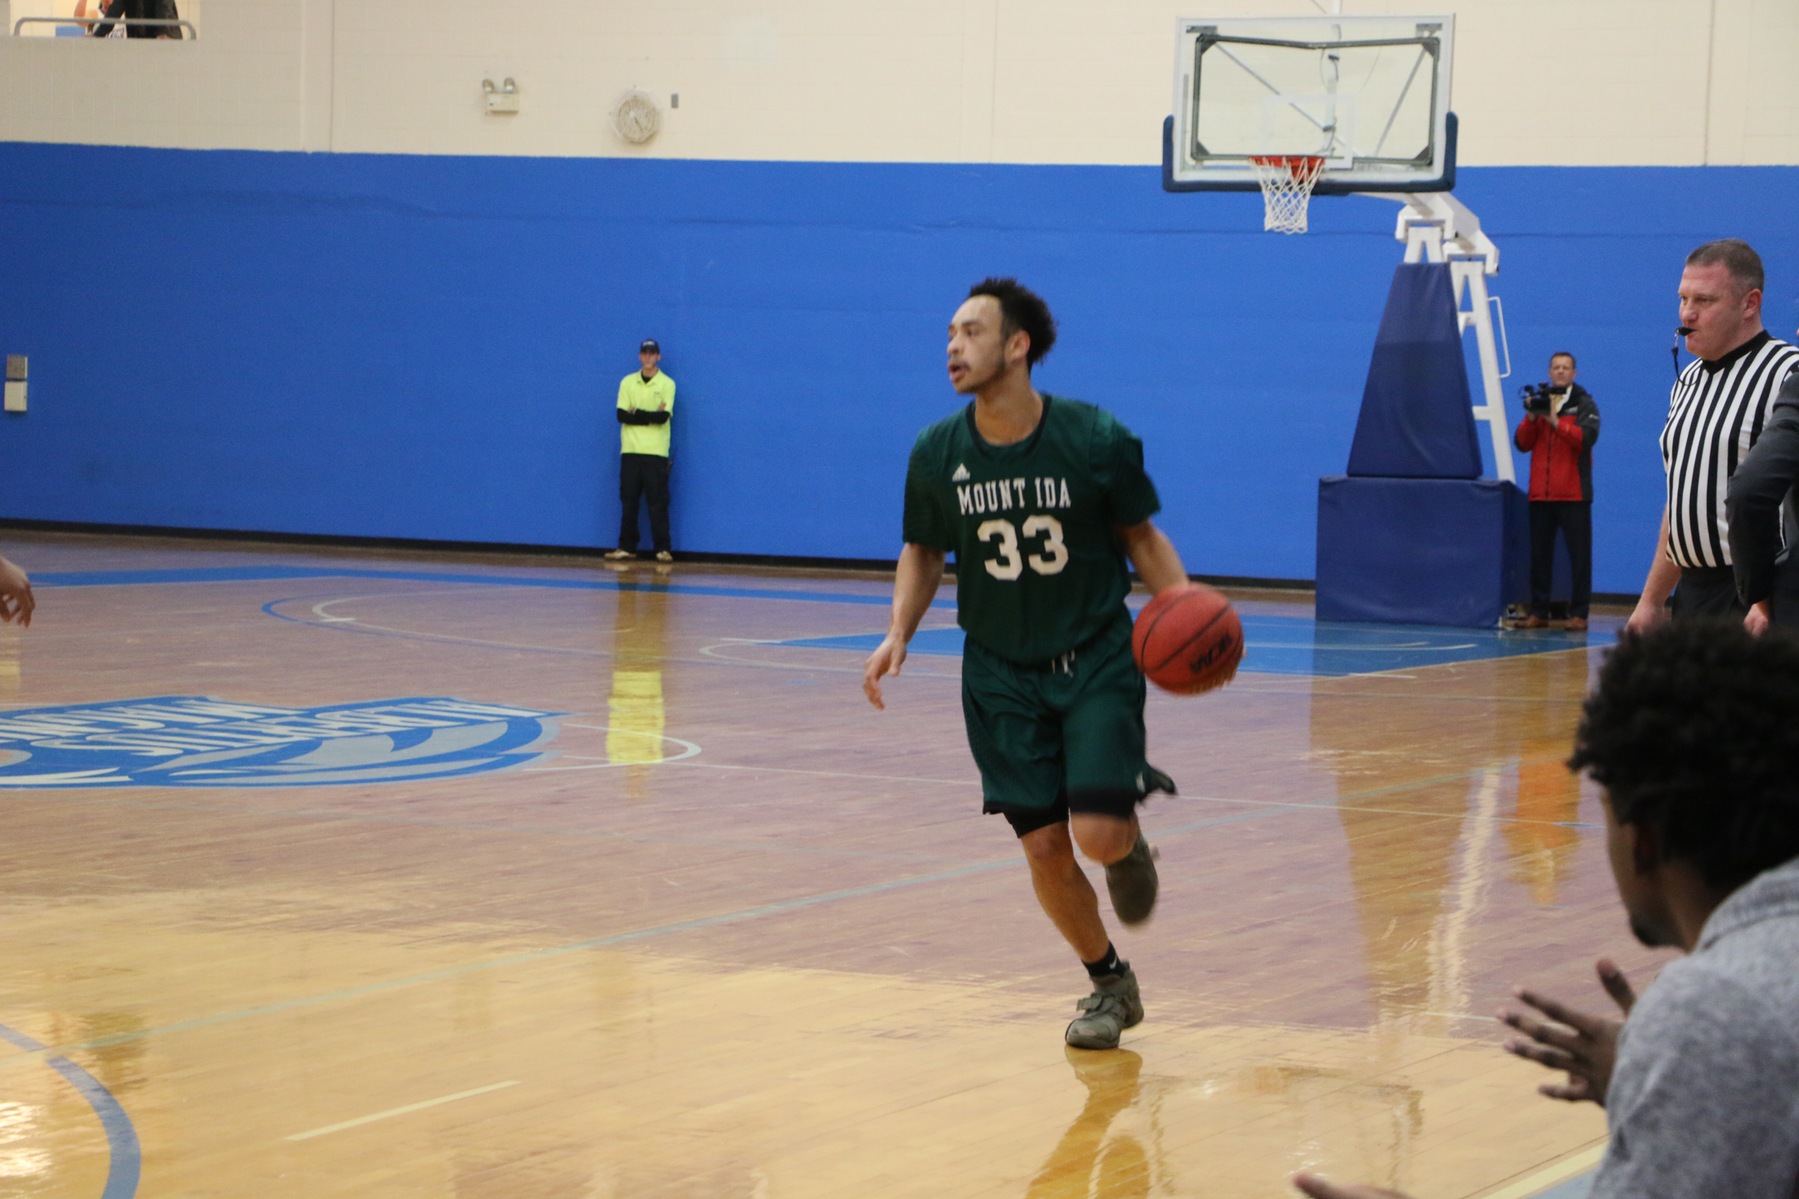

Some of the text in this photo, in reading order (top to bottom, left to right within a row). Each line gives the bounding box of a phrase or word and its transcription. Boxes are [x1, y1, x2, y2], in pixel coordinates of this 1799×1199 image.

[957, 477, 1072, 515] MOUNT IDA
[977, 514, 1069, 581] 33
[0, 699, 309, 743] MAGN
[30, 699, 549, 757] ALBERTUS
